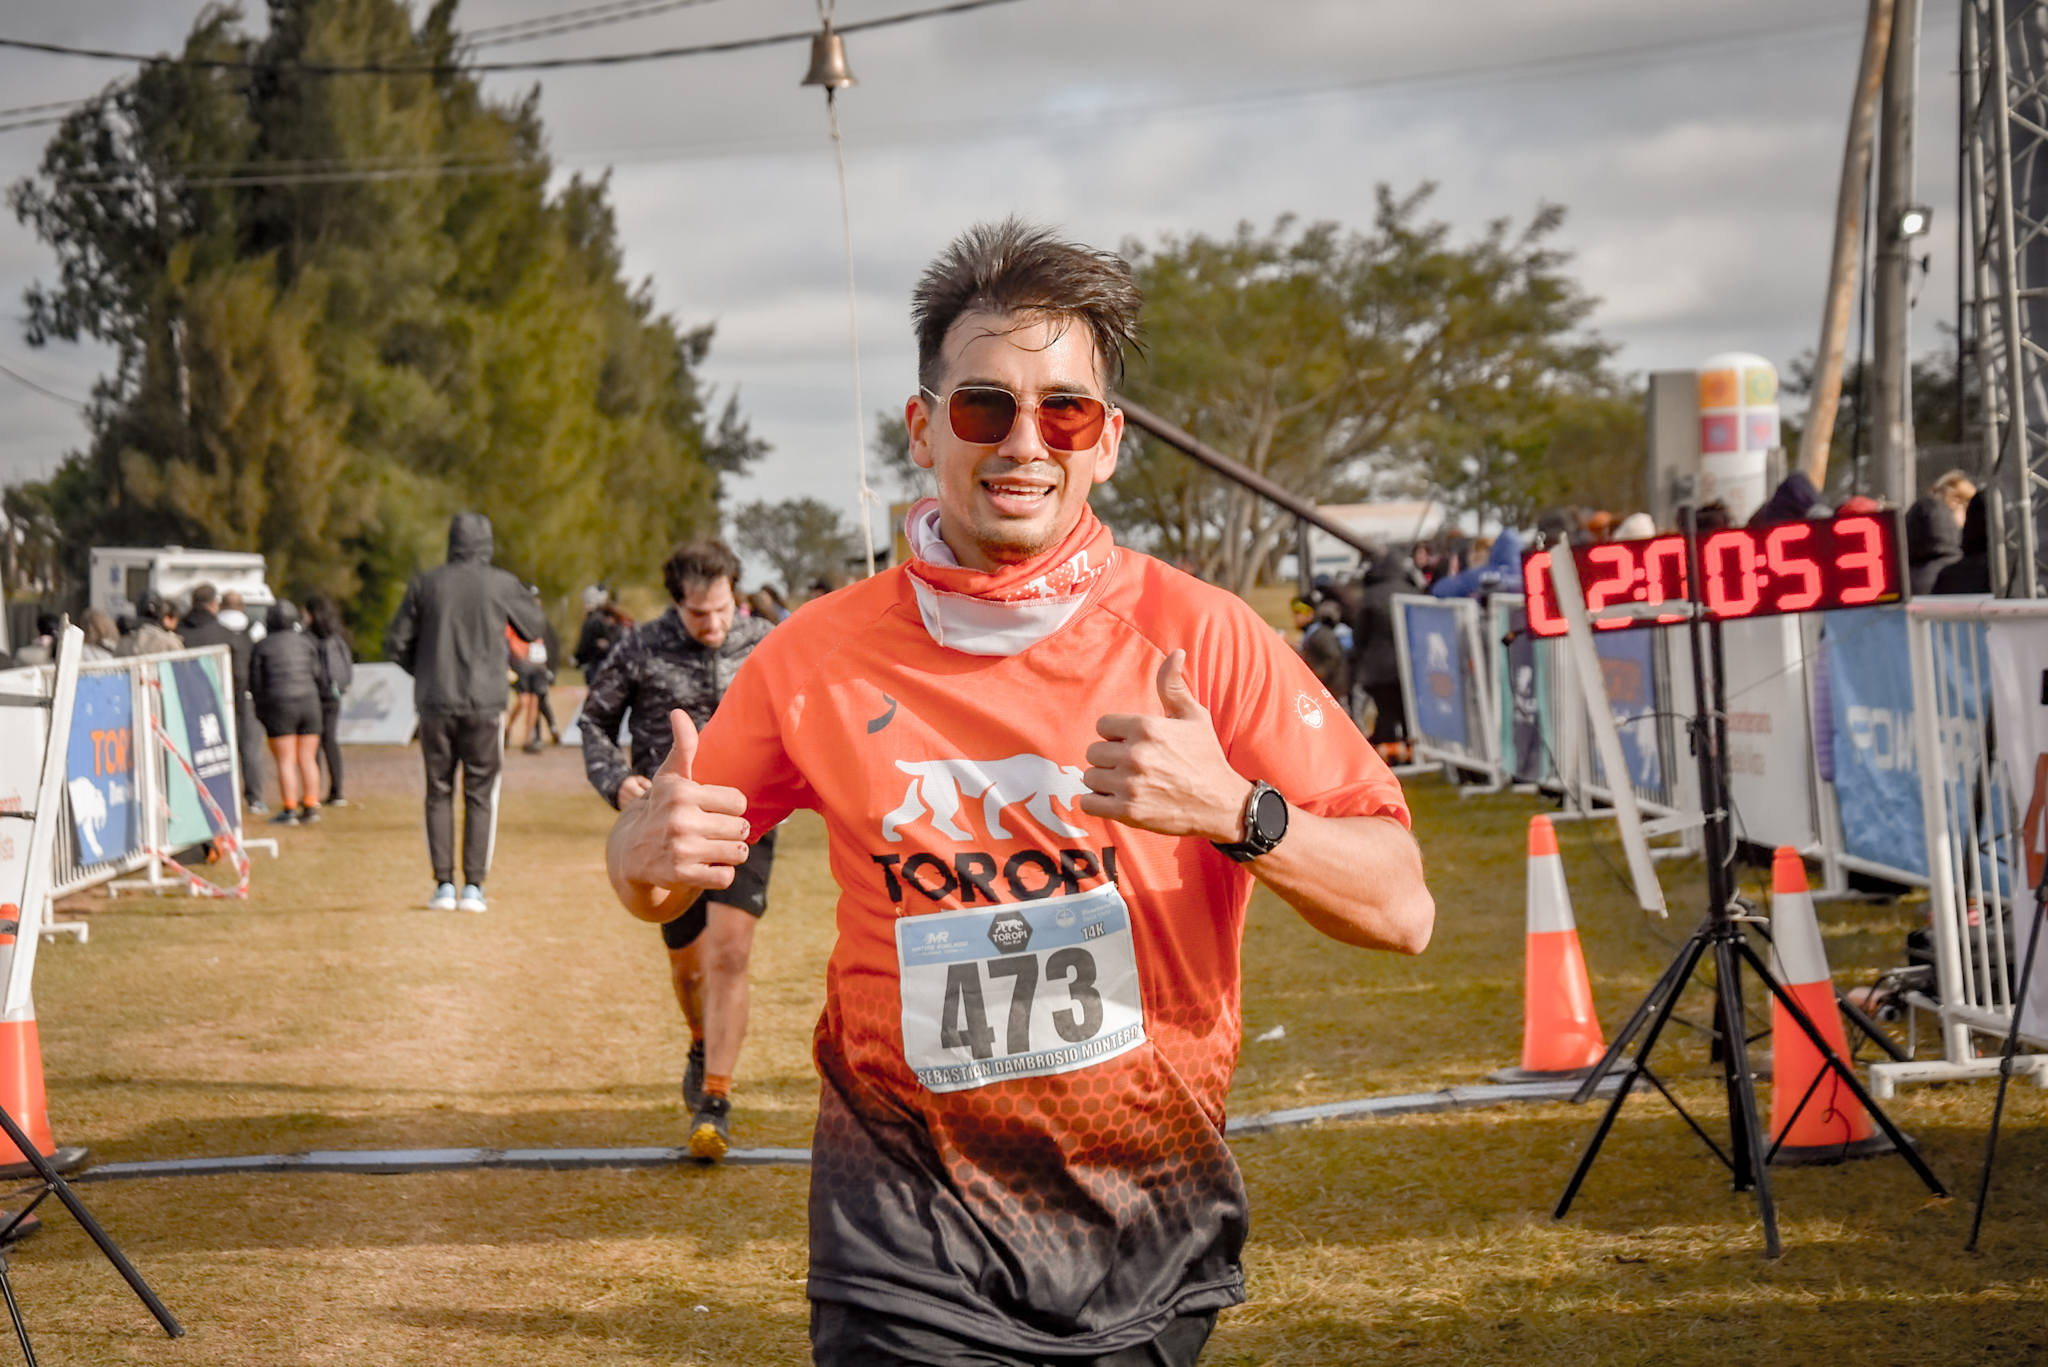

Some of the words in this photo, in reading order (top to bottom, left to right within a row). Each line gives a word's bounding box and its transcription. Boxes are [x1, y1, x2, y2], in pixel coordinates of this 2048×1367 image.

[871, 847, 1119, 903] TOROPI
[926, 931, 949, 944] MR
[992, 930, 1028, 943] TOROPI
[1082, 921, 1106, 941] 14K
[940, 947, 1104, 1060] 473
[917, 1063, 992, 1085] SEBASTIAN
[994, 1047, 1079, 1074] DAMBROSIO
[1081, 1024, 1140, 1059] MONTERO
